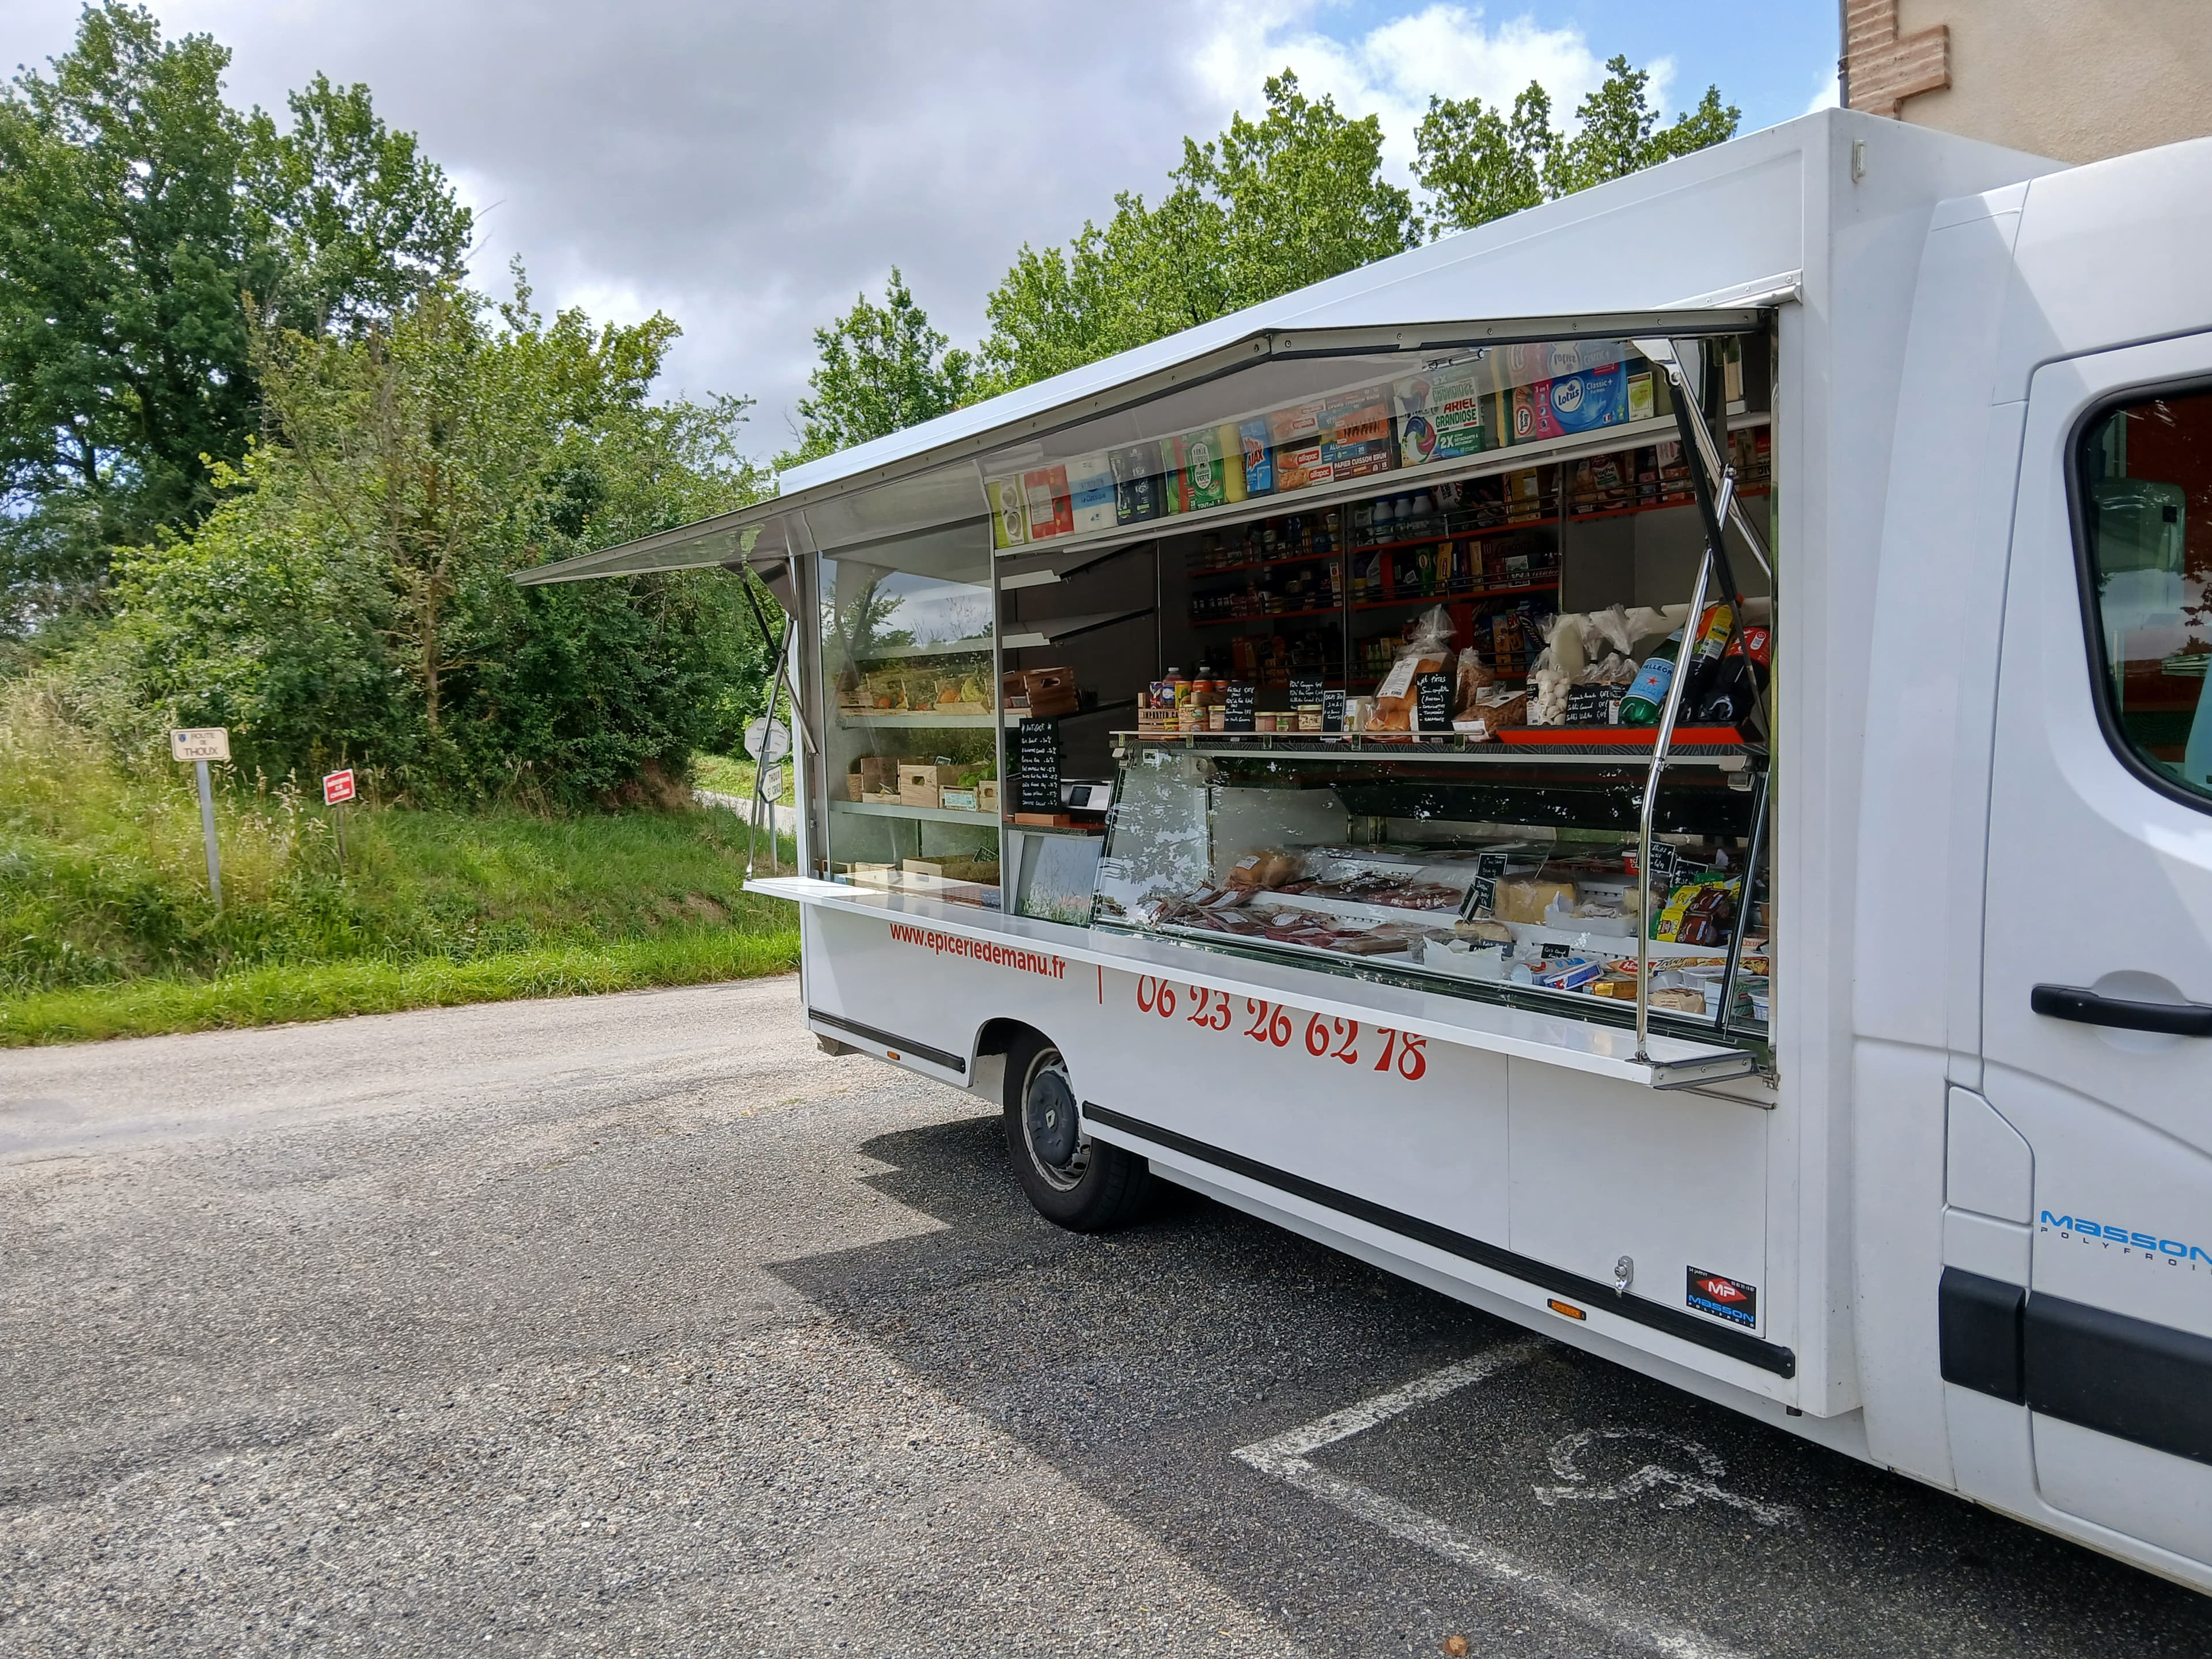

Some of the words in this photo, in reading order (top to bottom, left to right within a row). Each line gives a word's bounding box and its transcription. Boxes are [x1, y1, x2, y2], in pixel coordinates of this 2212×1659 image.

[1444, 397, 1476, 414] ARIEL
[1435, 408, 1477, 428] GRANDIOSE
[1248, 449, 1263, 469] AJAX
[1334, 460, 1351, 469] PAPIER
[1351, 454, 1372, 465] CUISSON
[1143, 711, 1169, 719] IMPORTED
[183, 747, 218, 756] THOUX
[889, 923, 1067, 979] www.epiceriedemanu.fr
[1137, 975, 1176, 1018] 06
[1187, 985, 1231, 1031] 23
[1243, 997, 1292, 1047] 26
[1305, 1013, 1359, 1065] 62
[1373, 1028, 1427, 1081] 78
[1707, 1281, 1736, 1298] MP
